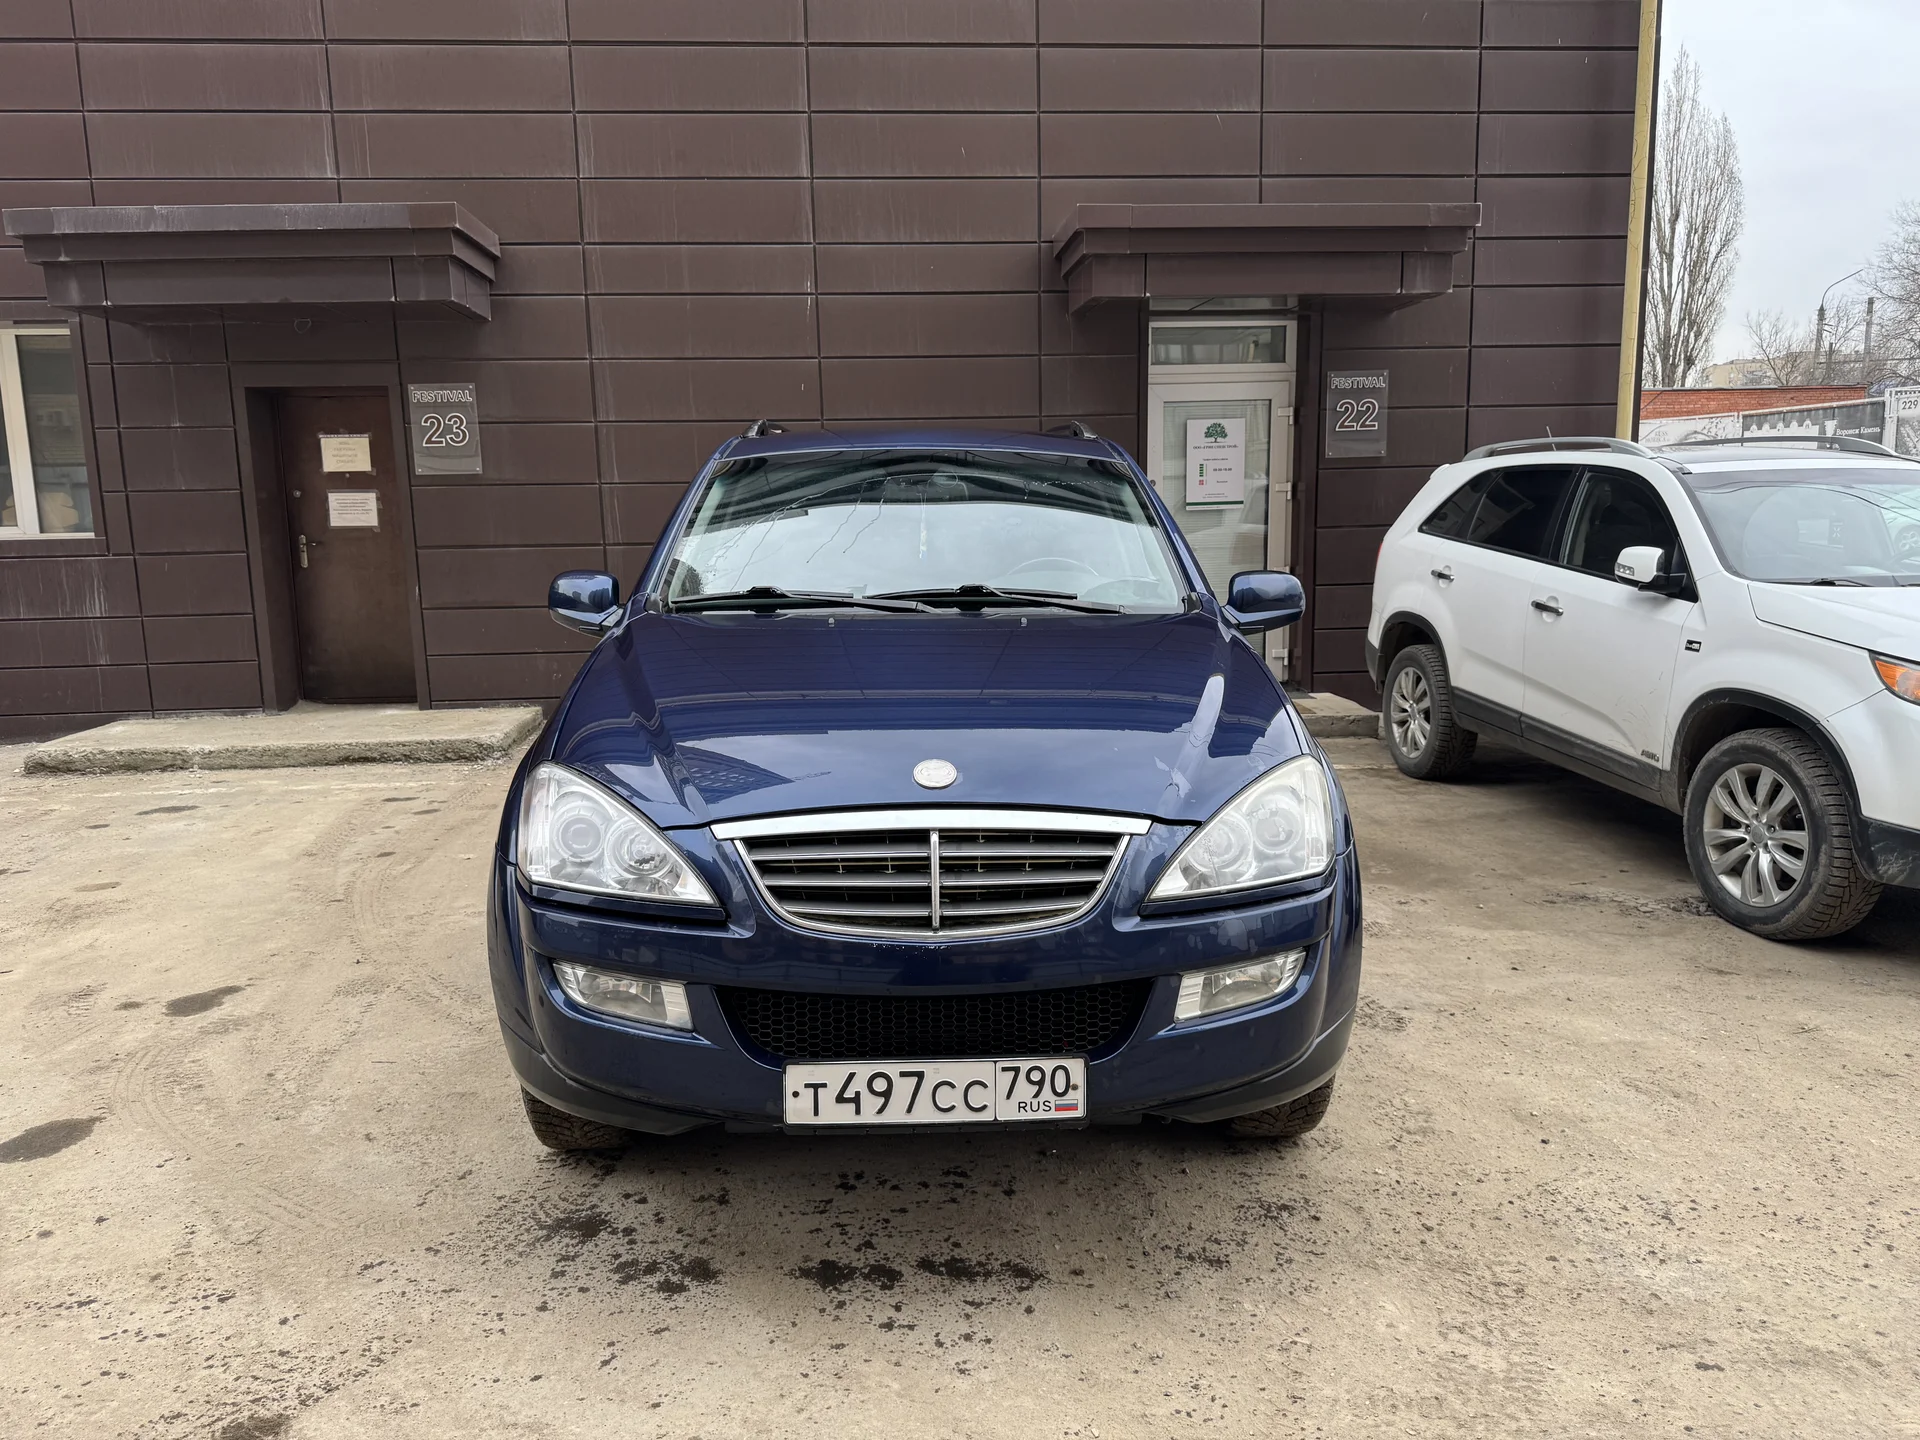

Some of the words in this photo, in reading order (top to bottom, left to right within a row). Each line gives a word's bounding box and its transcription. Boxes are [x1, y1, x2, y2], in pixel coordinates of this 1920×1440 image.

[1331, 376, 1386, 389] FESTIVAL
[412, 390, 473, 403] FESTIVAL
[1902, 400, 1919, 410] 229
[1335, 398, 1379, 431] 22
[421, 412, 470, 447] 23
[1836, 428, 1860, 436] Воронеж
[803, 1070, 989, 1117] Т497СС
[1000, 1064, 1072, 1100] 790
[1018, 1100, 1052, 1113] RUS
